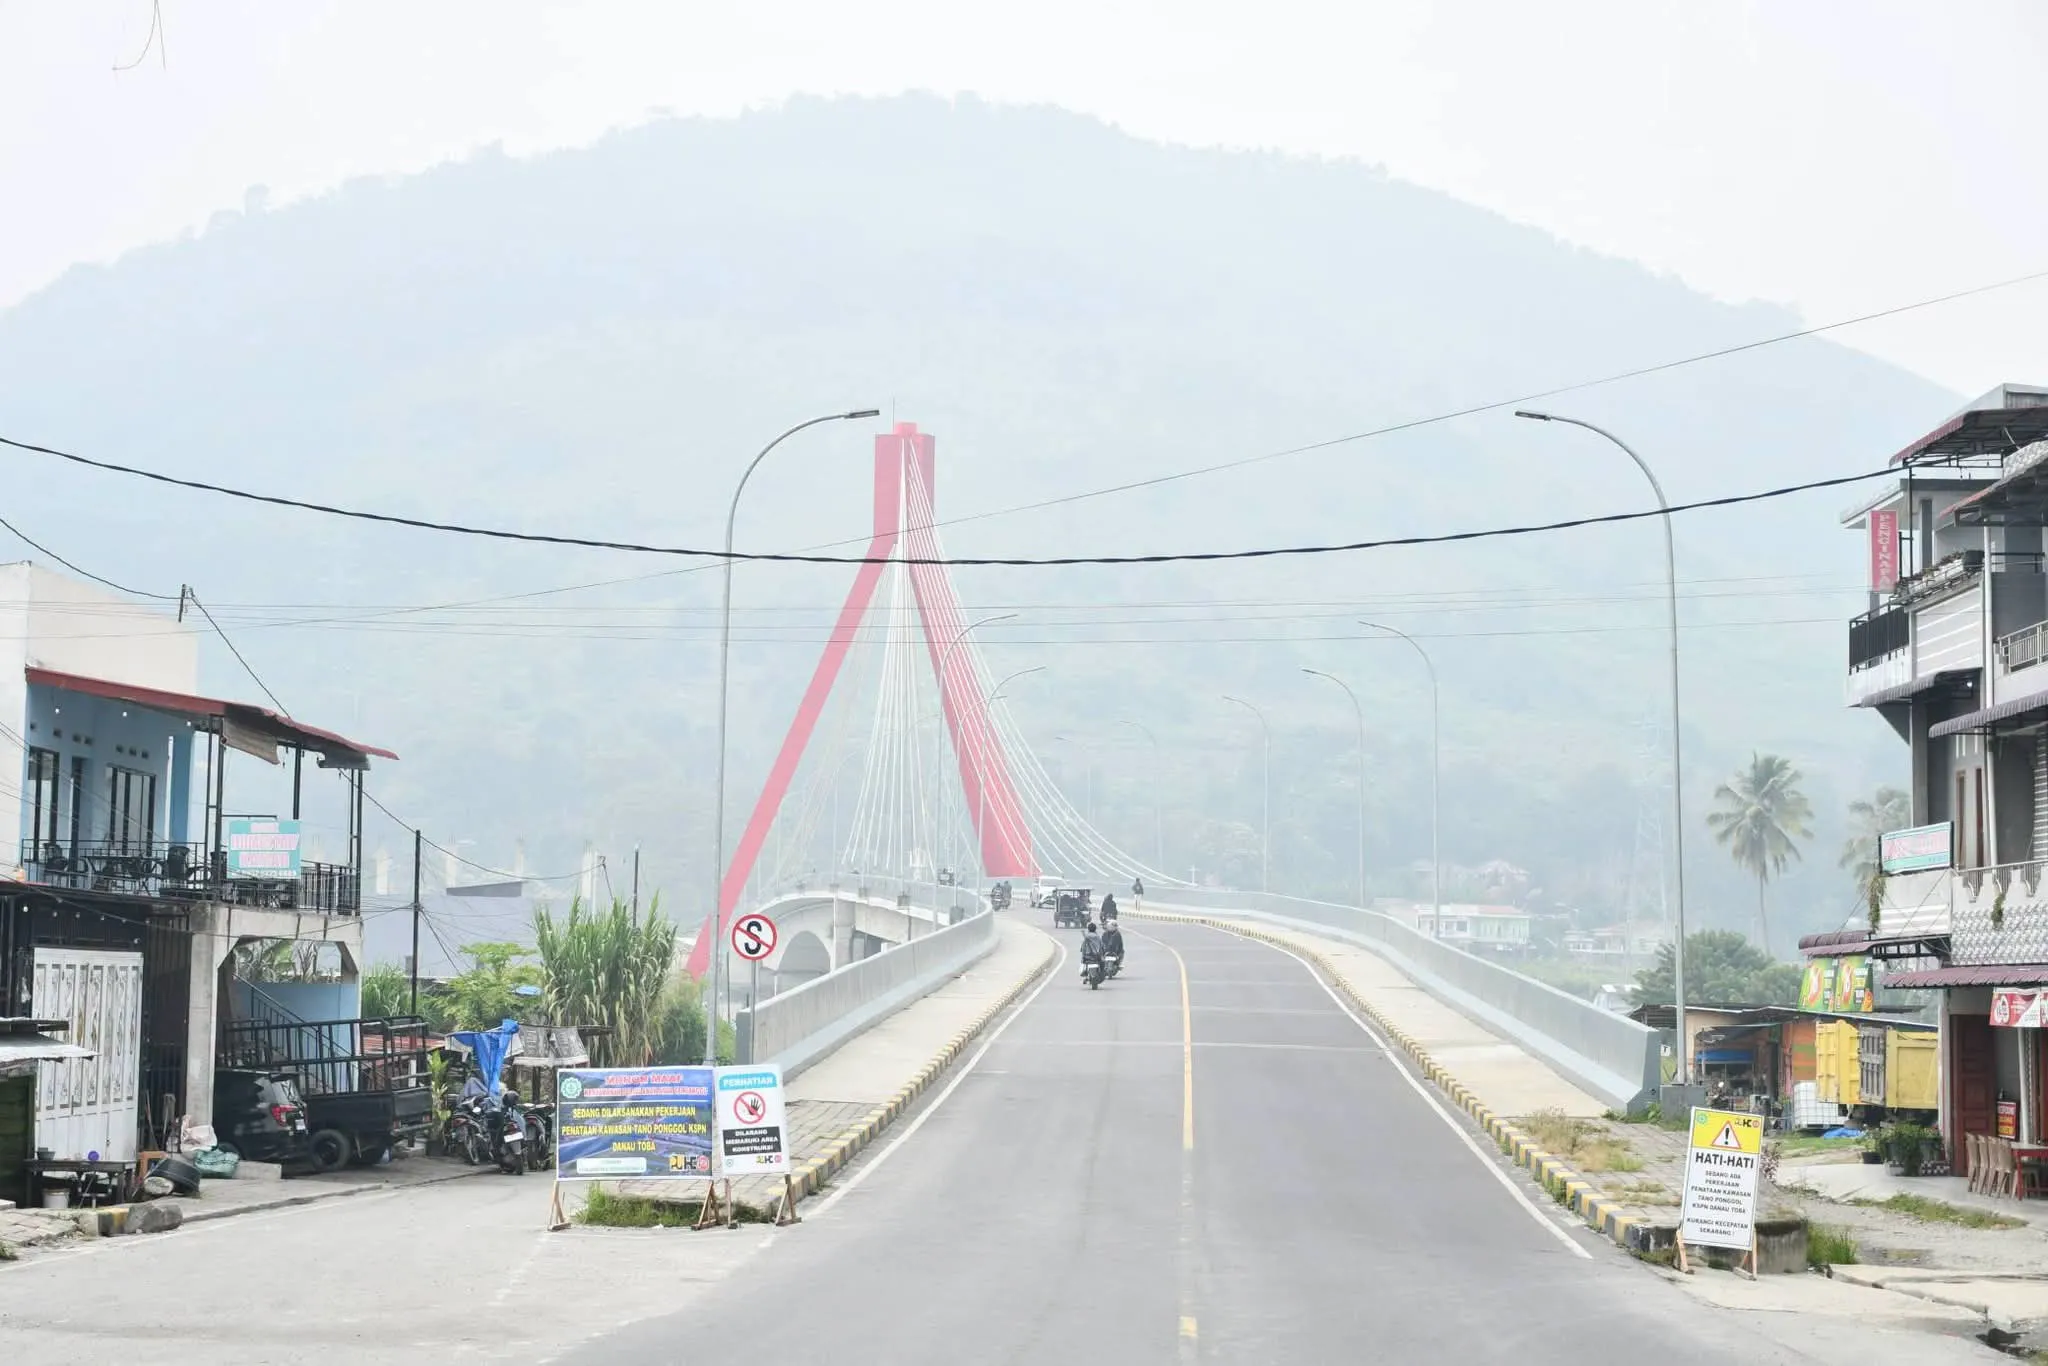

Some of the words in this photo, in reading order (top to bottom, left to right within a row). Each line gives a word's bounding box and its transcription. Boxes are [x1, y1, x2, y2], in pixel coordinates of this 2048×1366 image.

[744, 920, 762, 955] S
[723, 1077, 772, 1087] PERHATIAN
[572, 1108, 600, 1118] SEDANG
[601, 1107, 654, 1118] DILAKSANAKAN
[655, 1107, 696, 1117] PEKERJAAN
[562, 1125, 598, 1136] PENATAAN
[600, 1125, 632, 1135] KAWASAN
[634, 1124, 652, 1134] TANO
[653, 1123, 688, 1134] PONGGOL
[689, 1123, 707, 1135] KSPN
[726, 1137, 760, 1145] MEMASUKI
[612, 1142, 636, 1152] DANAU
[638, 1141, 656, 1151] TOBA
[732, 1144, 774, 1152] KONSTRUKSI
[1695, 1152, 1754, 1169] HATI-HATI
[1705, 1170, 1729, 1178] SEDANG
[1705, 1179, 1740, 1187] PEKERJAAN
[1691, 1185, 1722, 1194] PENATAAN
[1722, 1189, 1752, 1197] KAWASAN
[1715, 1197, 1743, 1205] PONGGOL
[1687, 1217, 1714, 1225] KURANGI
[1715, 1221, 1749, 1229] KECEPATAN
[1699, 1227, 1732, 1236] SEKARANG
